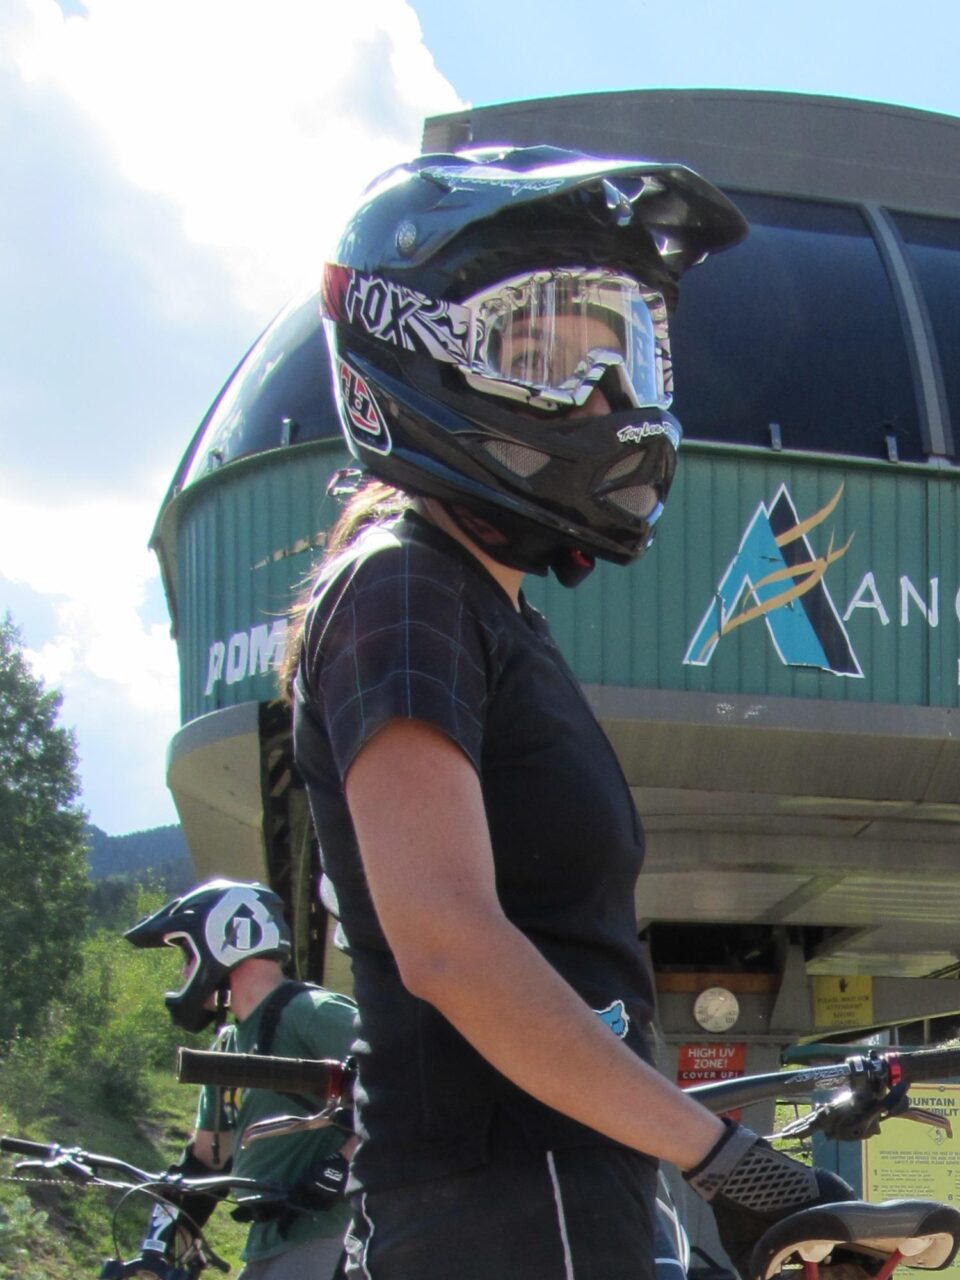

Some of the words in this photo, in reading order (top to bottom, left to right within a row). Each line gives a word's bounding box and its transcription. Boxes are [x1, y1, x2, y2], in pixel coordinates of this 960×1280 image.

[205, 618, 289, 696] POM
[688, 1048, 716, 1058] HIGH
[719, 1047, 736, 1057] UV
[694, 1058, 728, 1069] ZONE!
[682, 1071, 716, 1079] COVER
[720, 1071, 738, 1079] UP!
[907, 1097, 955, 1107] UNTAIN
